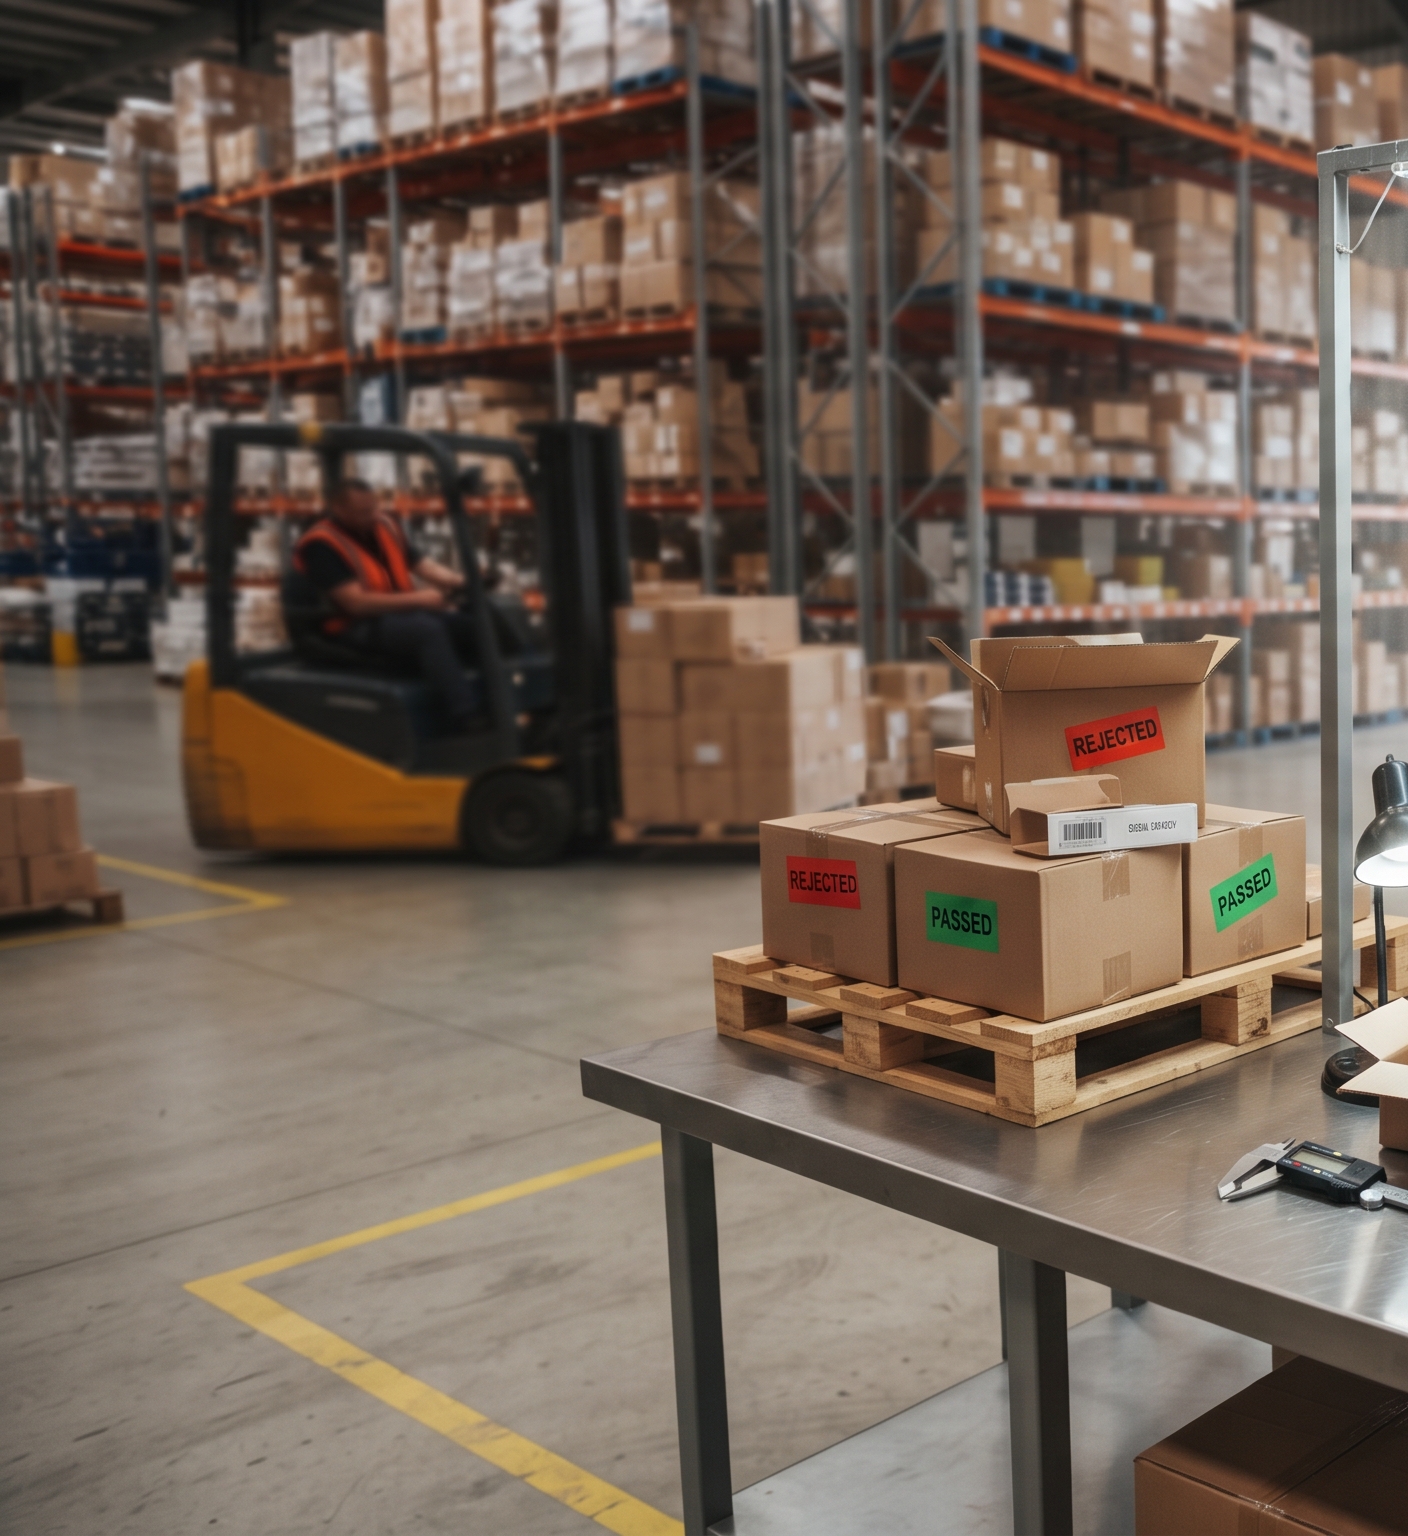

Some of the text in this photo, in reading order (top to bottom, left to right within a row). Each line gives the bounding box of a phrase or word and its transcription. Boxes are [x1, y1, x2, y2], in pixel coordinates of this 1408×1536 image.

[1072, 718, 1158, 757] REJECTED
[790, 869, 857, 893] REJECTED
[1217, 867, 1271, 917] PASSED
[931, 905, 992, 936] PASSED
